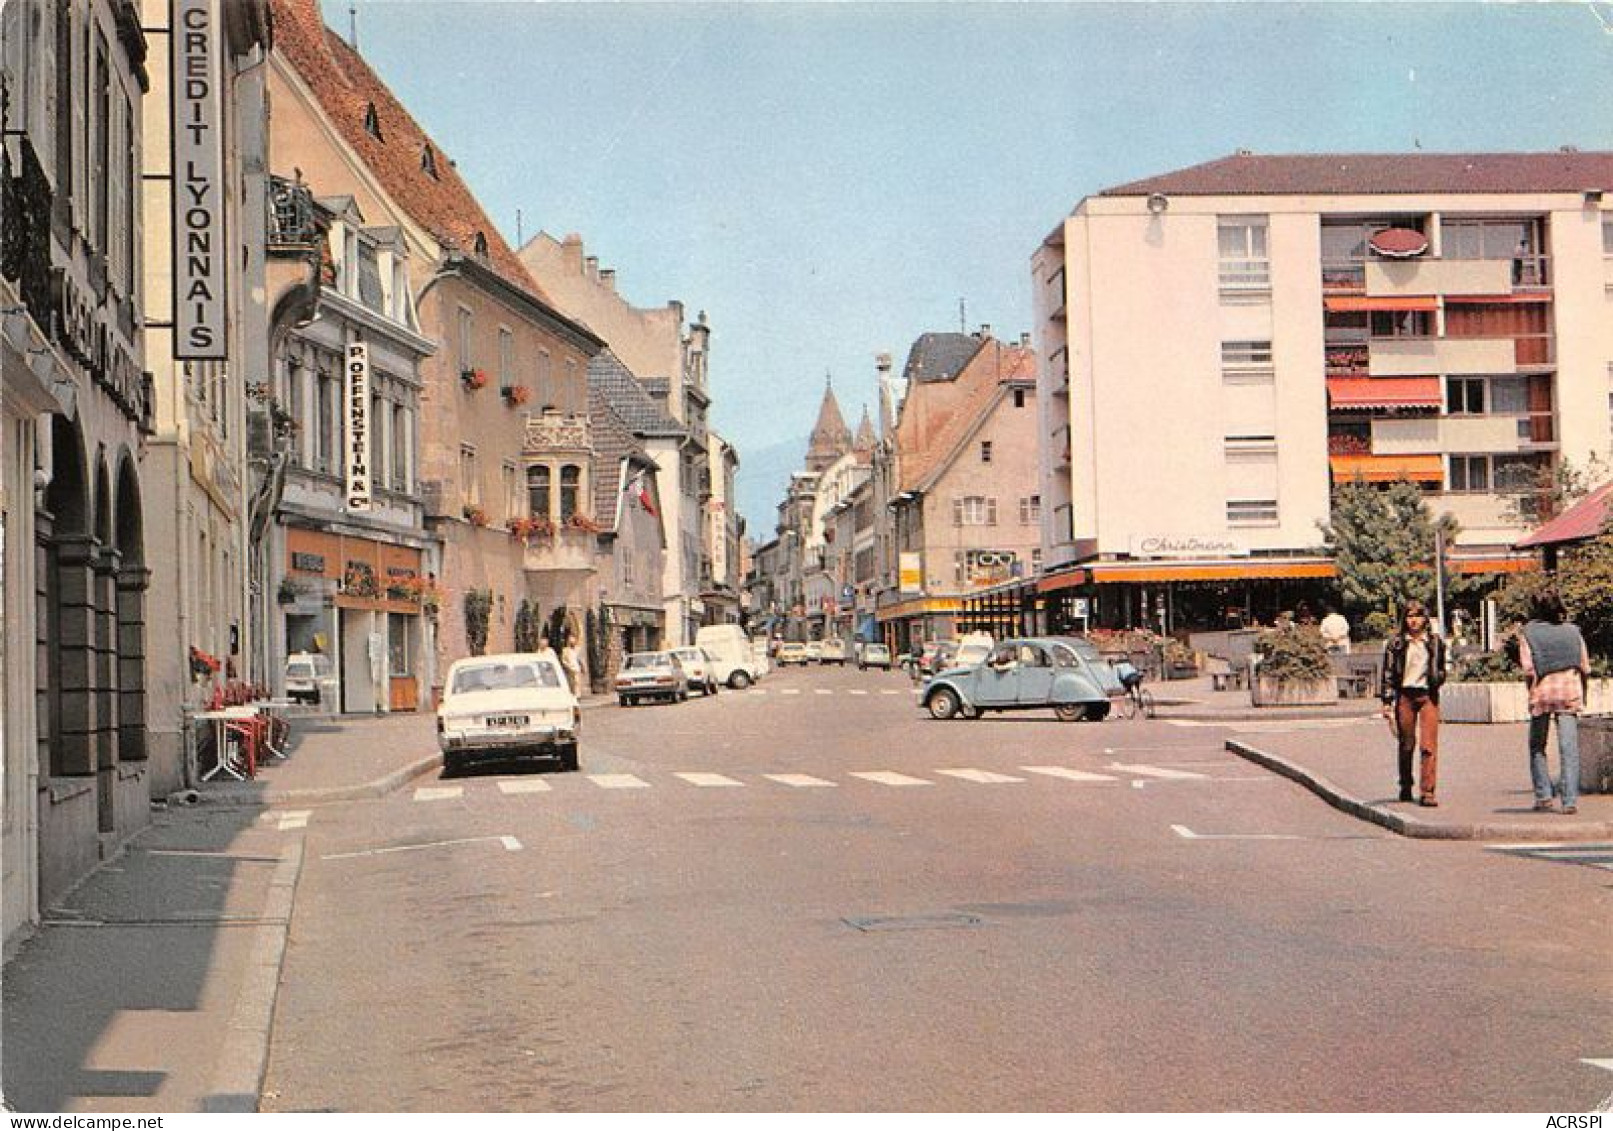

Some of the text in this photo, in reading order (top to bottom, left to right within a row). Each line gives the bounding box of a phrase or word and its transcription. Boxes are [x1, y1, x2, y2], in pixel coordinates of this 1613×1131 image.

[184, 7, 213, 348] CREDIT LYONNAIS
[350, 362, 365, 477] OFFENSTEIN
